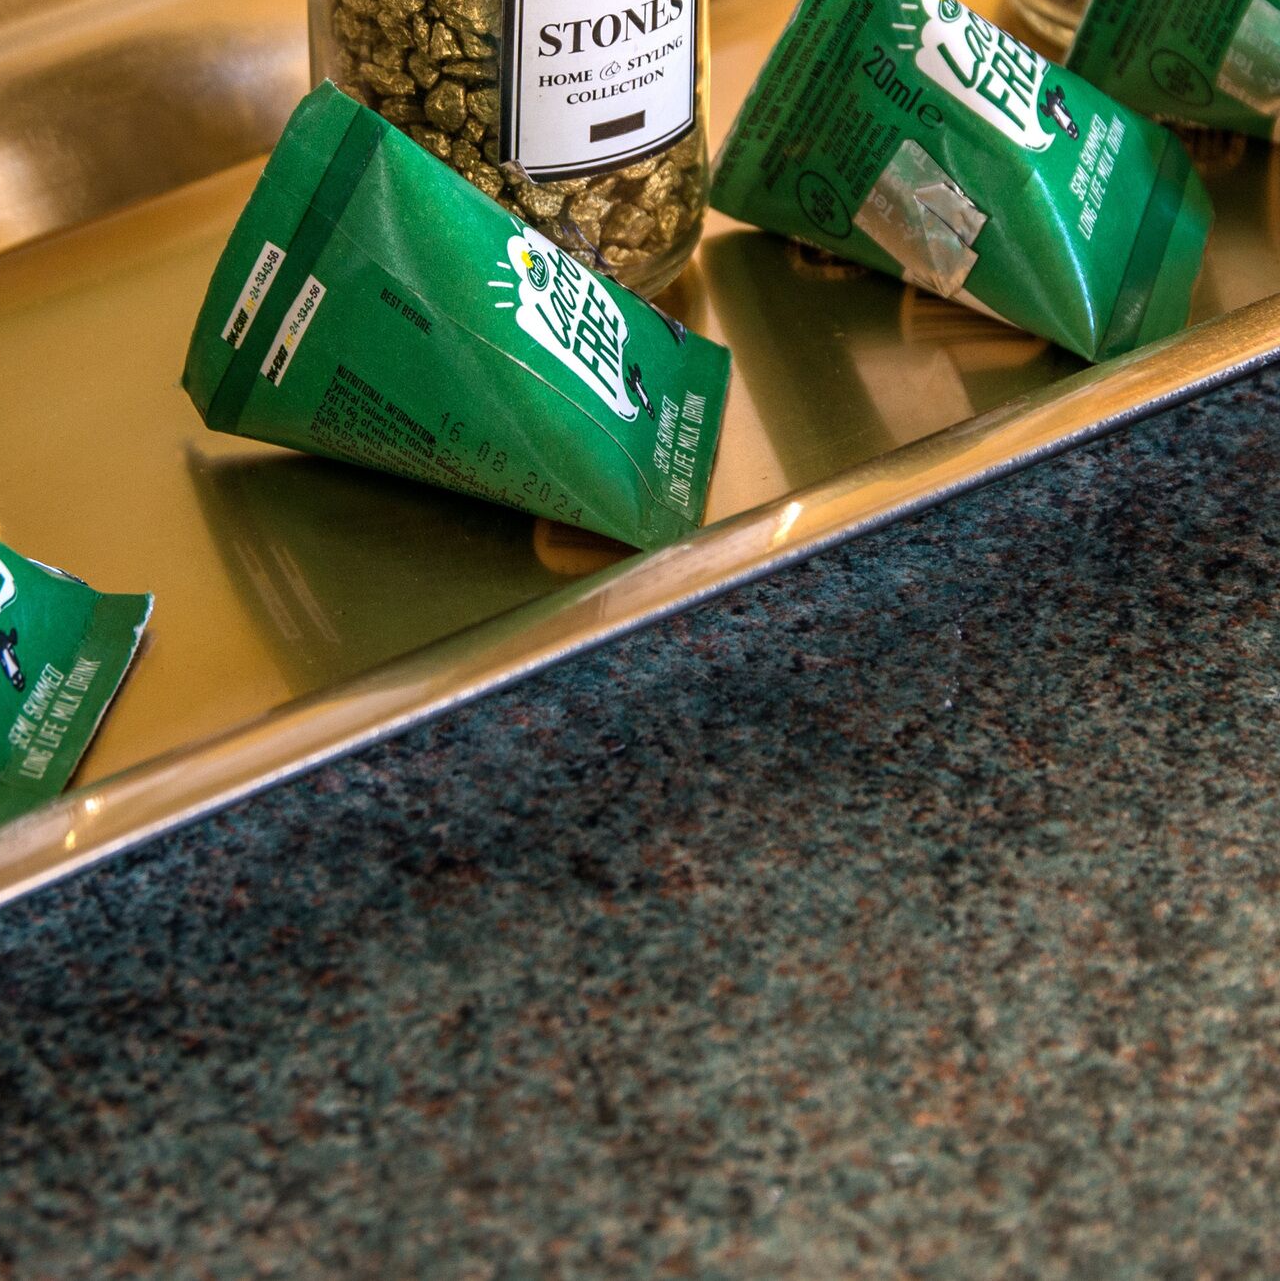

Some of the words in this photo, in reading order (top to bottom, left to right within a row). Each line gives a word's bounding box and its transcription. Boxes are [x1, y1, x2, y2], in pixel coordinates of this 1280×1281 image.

[538, 69, 593, 88] HOME
[627, 35, 683, 72] STYLING
[860, 44, 921, 114] 20ml
[566, 67, 665, 105] COLLECTION
[1070, 163, 1090, 202] SEMI
[1080, 112, 1108, 172] SKIMMED
[1078, 200, 1098, 241] LONG
[1088, 174, 1106, 210] LIFE
[1097, 145, 1115, 184] MILK
[380, 288, 402, 309] BEST
[535, 248, 582, 350] Lacto
[572, 280, 619, 400] FREE
[336, 364, 384, 407] NUTRITIONAL
[328, 377, 361, 405] Typical
[360, 400, 388, 426] Values
[388, 423, 403, 437] Per
[656, 394, 680, 449] SKIMMED
[681, 389, 707, 424] DRINK
[356, 429, 383, 449] which
[371, 425, 398, 447] which
[677, 421, 700, 453] MILK
[653, 441, 671, 475] SEMI
[672, 449, 696, 478] LIFE
[668, 474, 691, 507] LONG
[22, 662, 65, 720] SKIMMED
[65, 657, 101, 691] DRINK
[50, 690, 84, 722] MILK
[8, 713, 38, 750] SEMI
[35, 720, 68, 749] LIFE
[19, 747, 54, 780] LONG
